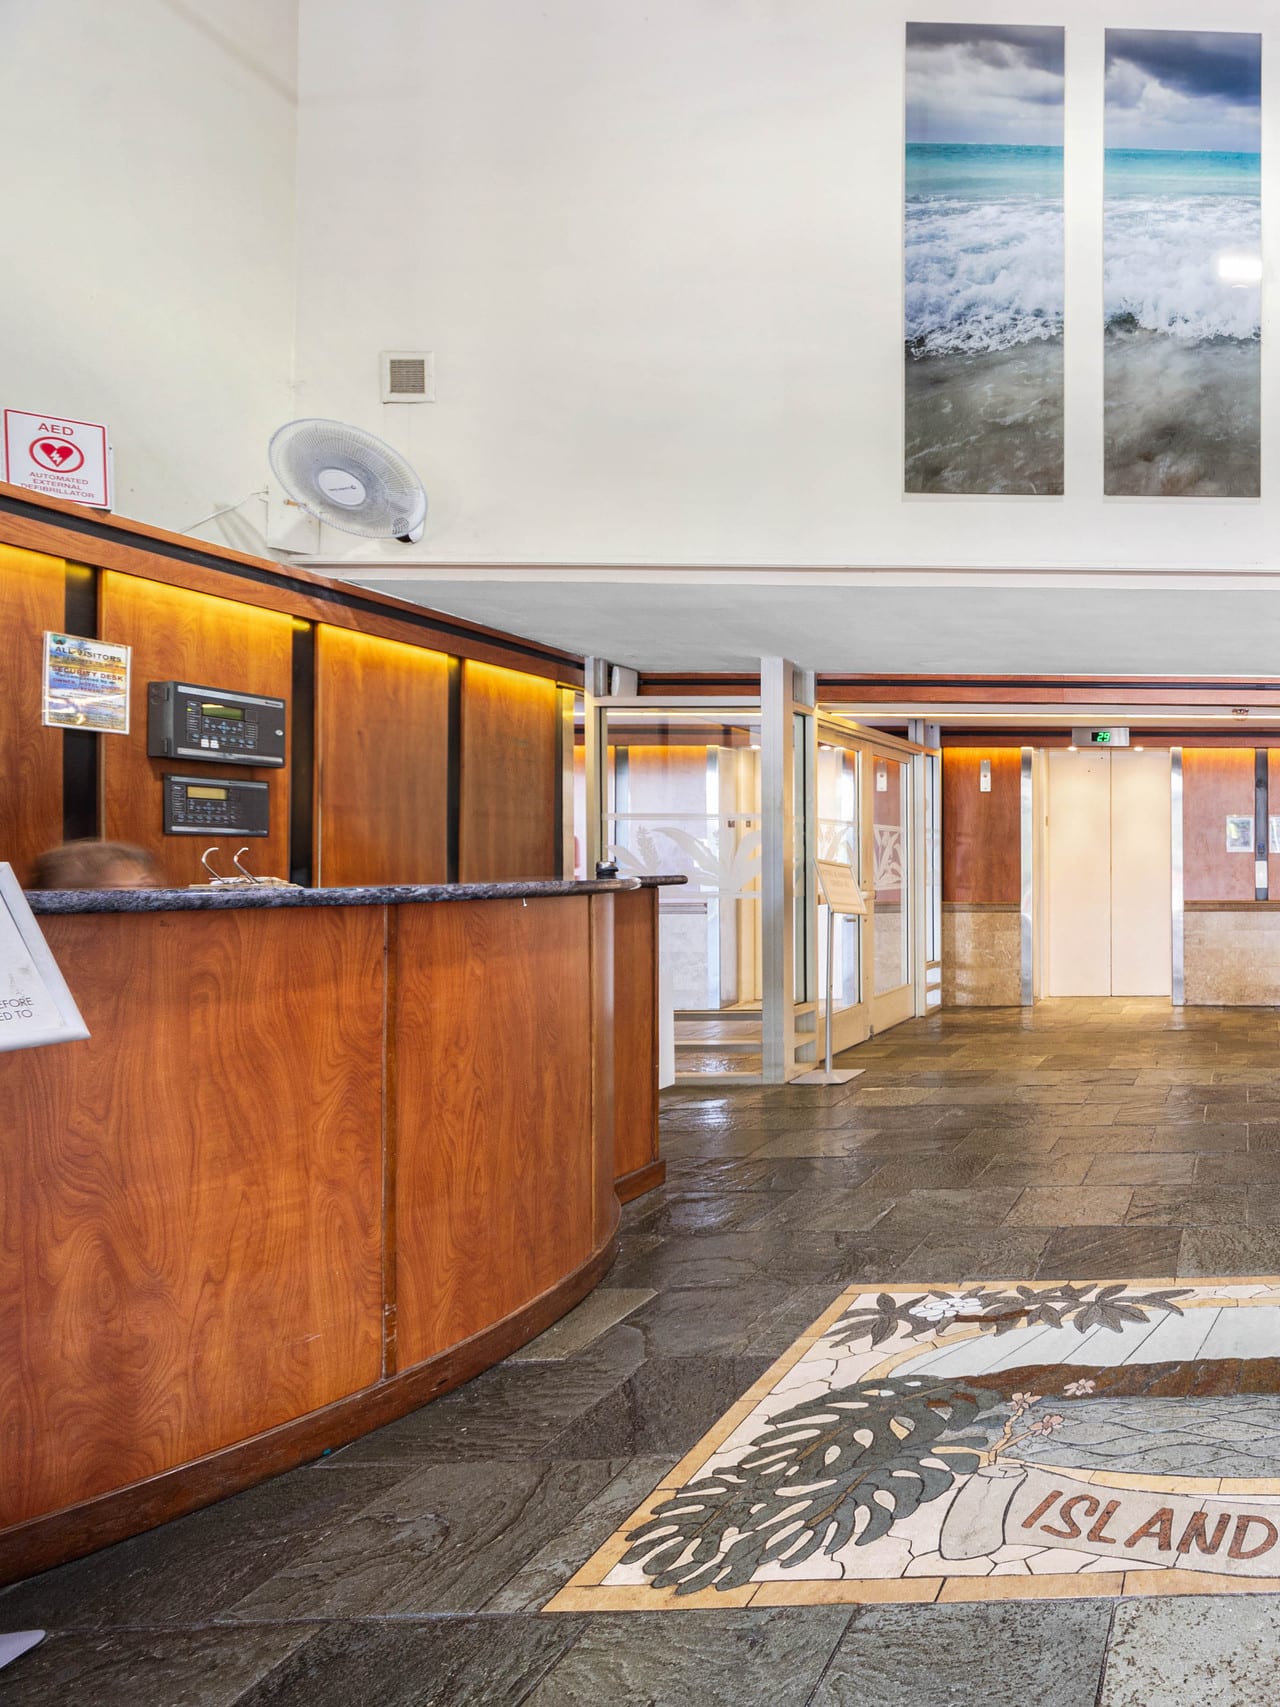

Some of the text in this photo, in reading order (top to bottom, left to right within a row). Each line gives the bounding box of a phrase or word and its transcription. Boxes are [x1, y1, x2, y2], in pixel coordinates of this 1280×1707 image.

[38, 422, 74, 436] AED
[29, 471, 89, 485] AUTOMATED
[33, 478, 82, 491] EXTERNAL
[20, 483, 95, 499] DEFIBRILLATOR
[55, 646, 74, 655] ALL
[77, 648, 122, 663] VISITORS
[51, 665, 97, 678] SECURITY
[100, 672, 123, 682] DESK
[1097, 732, 1110, 742] 29
[14, 1009, 33, 1019] TO
[1021, 1489, 1279, 1560] ISLAND
